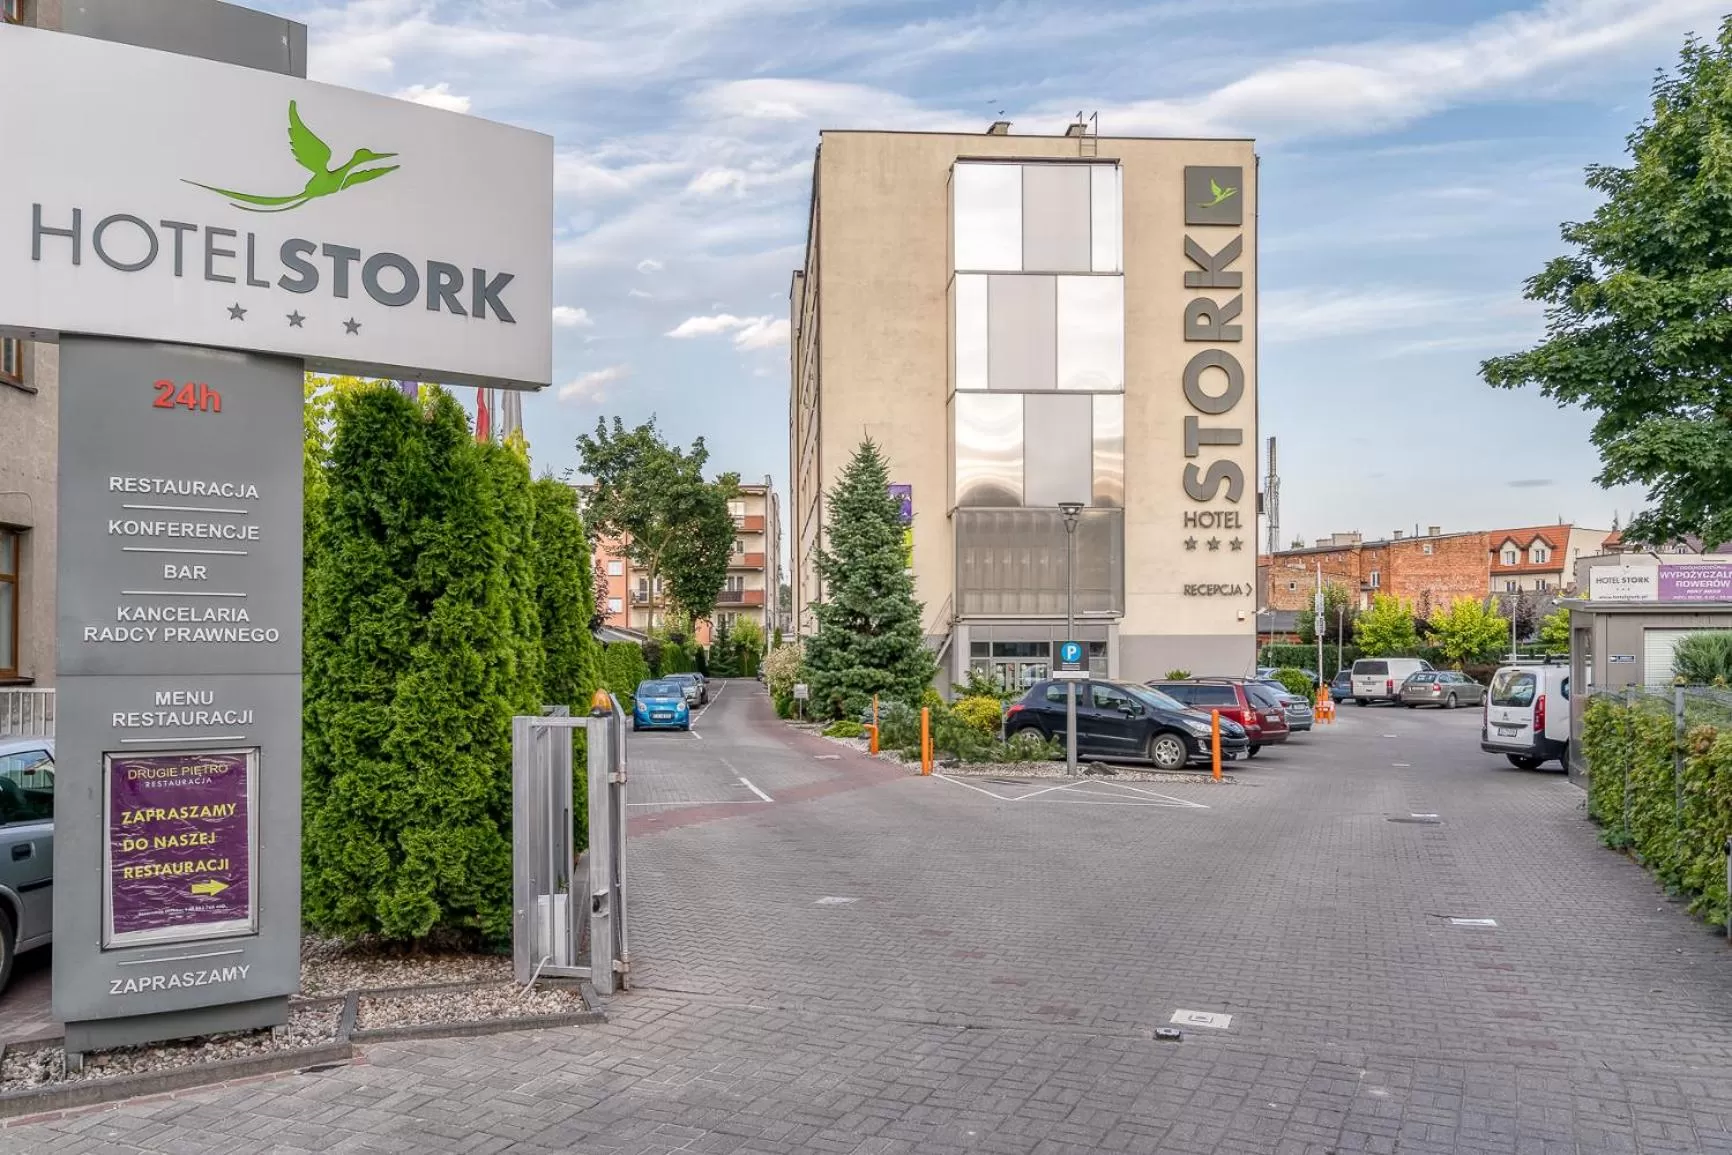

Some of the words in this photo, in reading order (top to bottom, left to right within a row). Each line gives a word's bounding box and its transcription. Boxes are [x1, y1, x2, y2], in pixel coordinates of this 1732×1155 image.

[1182, 233, 1245, 504] STORK
[153, 379, 223, 413] 24h
[108, 475, 260, 499] RESTAURACJA
[107, 519, 261, 541] KONFERENCJE
[1183, 510, 1243, 530] HOTEL
[163, 564, 208, 581] BAR
[1183, 583, 1243, 597] RECEPCJA
[116, 606, 250, 623] KANCELARIA
[83, 626, 156, 642] RADCY
[164, 627, 280, 643] PRAWNEGO
[154, 690, 215, 706] MENU
[111, 709, 254, 728] RESTAURACJI
[127, 766, 178, 781] DRUGIE
[181, 763, 229, 777] PIĘTRO
[145, 777, 213, 788] RESTAURACJA
[121, 802, 237, 825] ZAPRASZAMY
[122, 837, 149, 852] DO
[154, 831, 217, 849] NASZEJ
[123, 858, 230, 880] RESTAURACJI
[108, 964, 251, 996] ZAPRASZAMY
